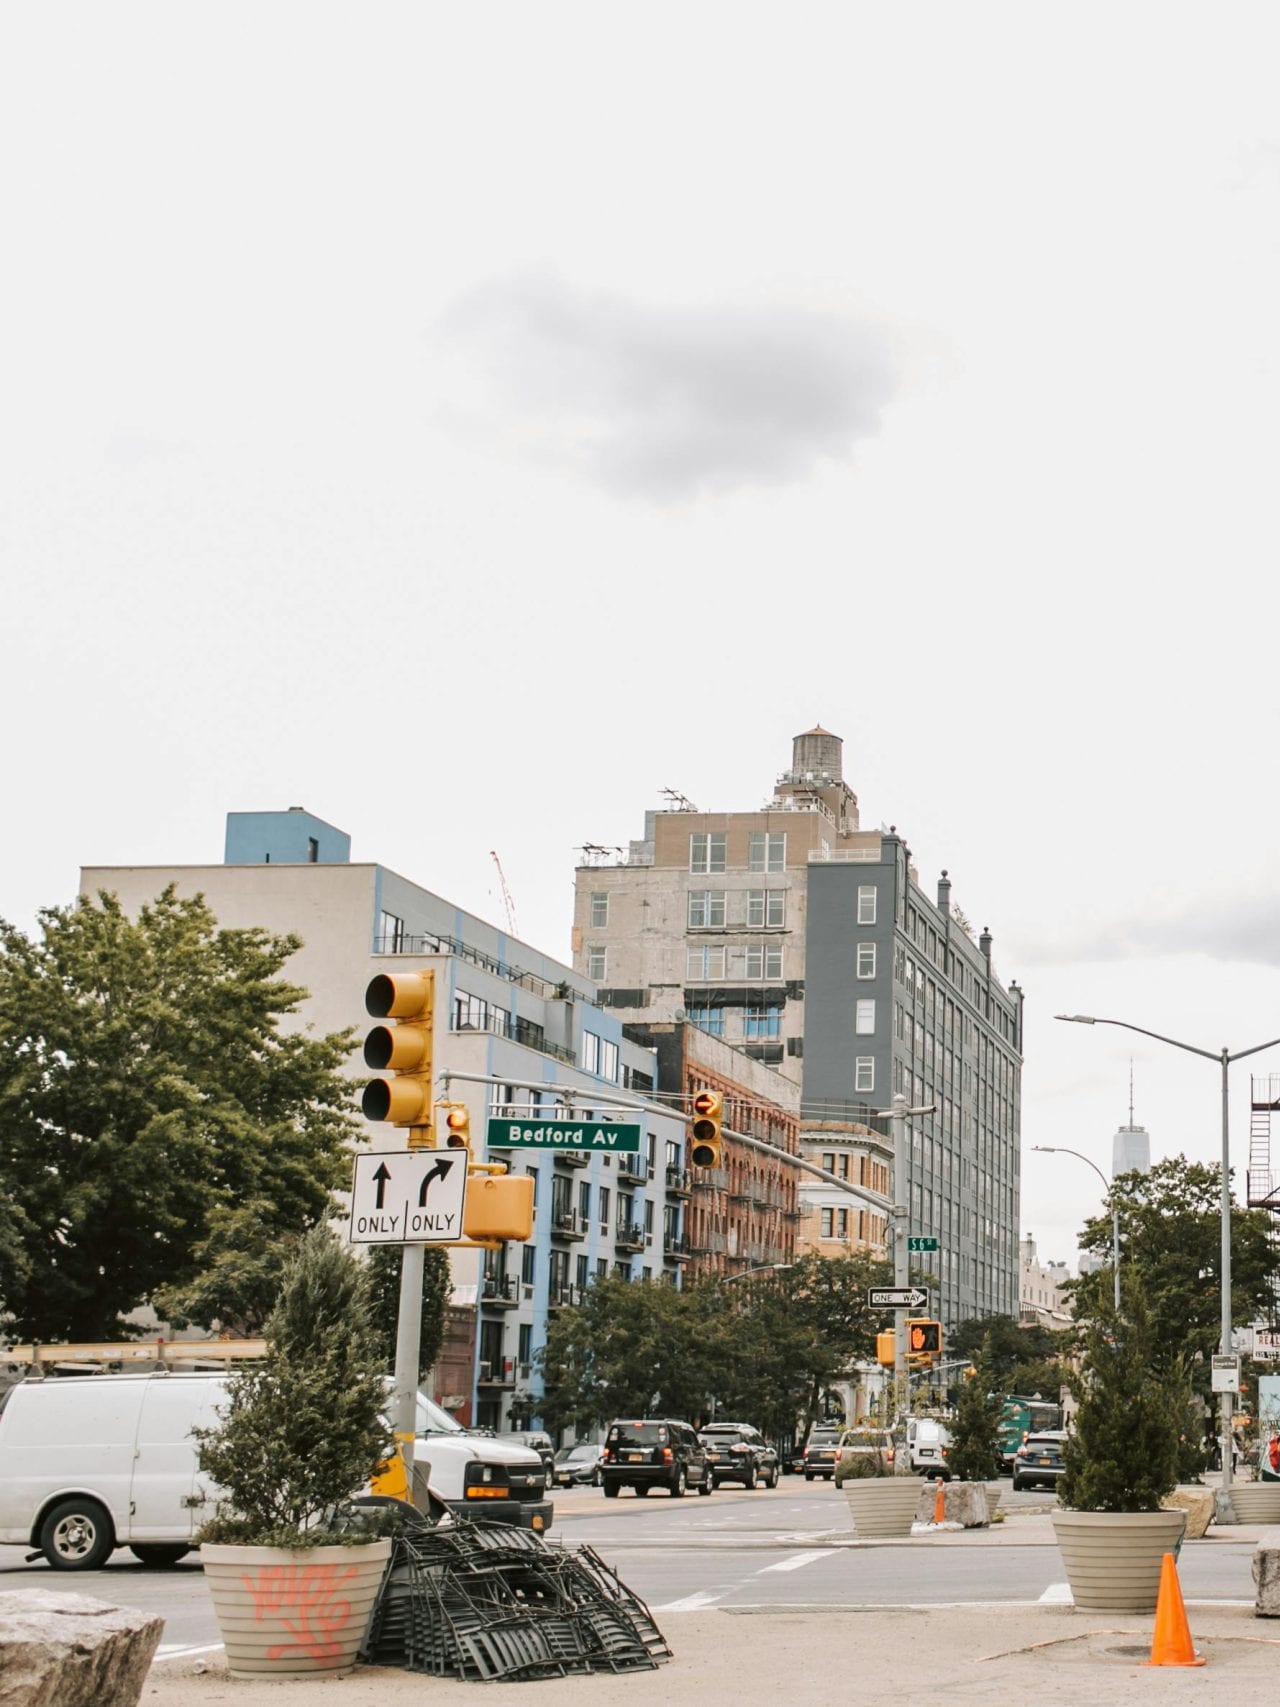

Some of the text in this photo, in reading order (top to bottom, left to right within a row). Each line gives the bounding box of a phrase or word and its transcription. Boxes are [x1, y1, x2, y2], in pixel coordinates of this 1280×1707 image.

[508, 1125, 618, 1145] Bedford Av
[357, 1213, 455, 1234] ONLY ONLY
[911, 1238, 917, 1251] S
[919, 1238, 925, 1251] 6
[874, 1294, 921, 1303] ONE WAY
